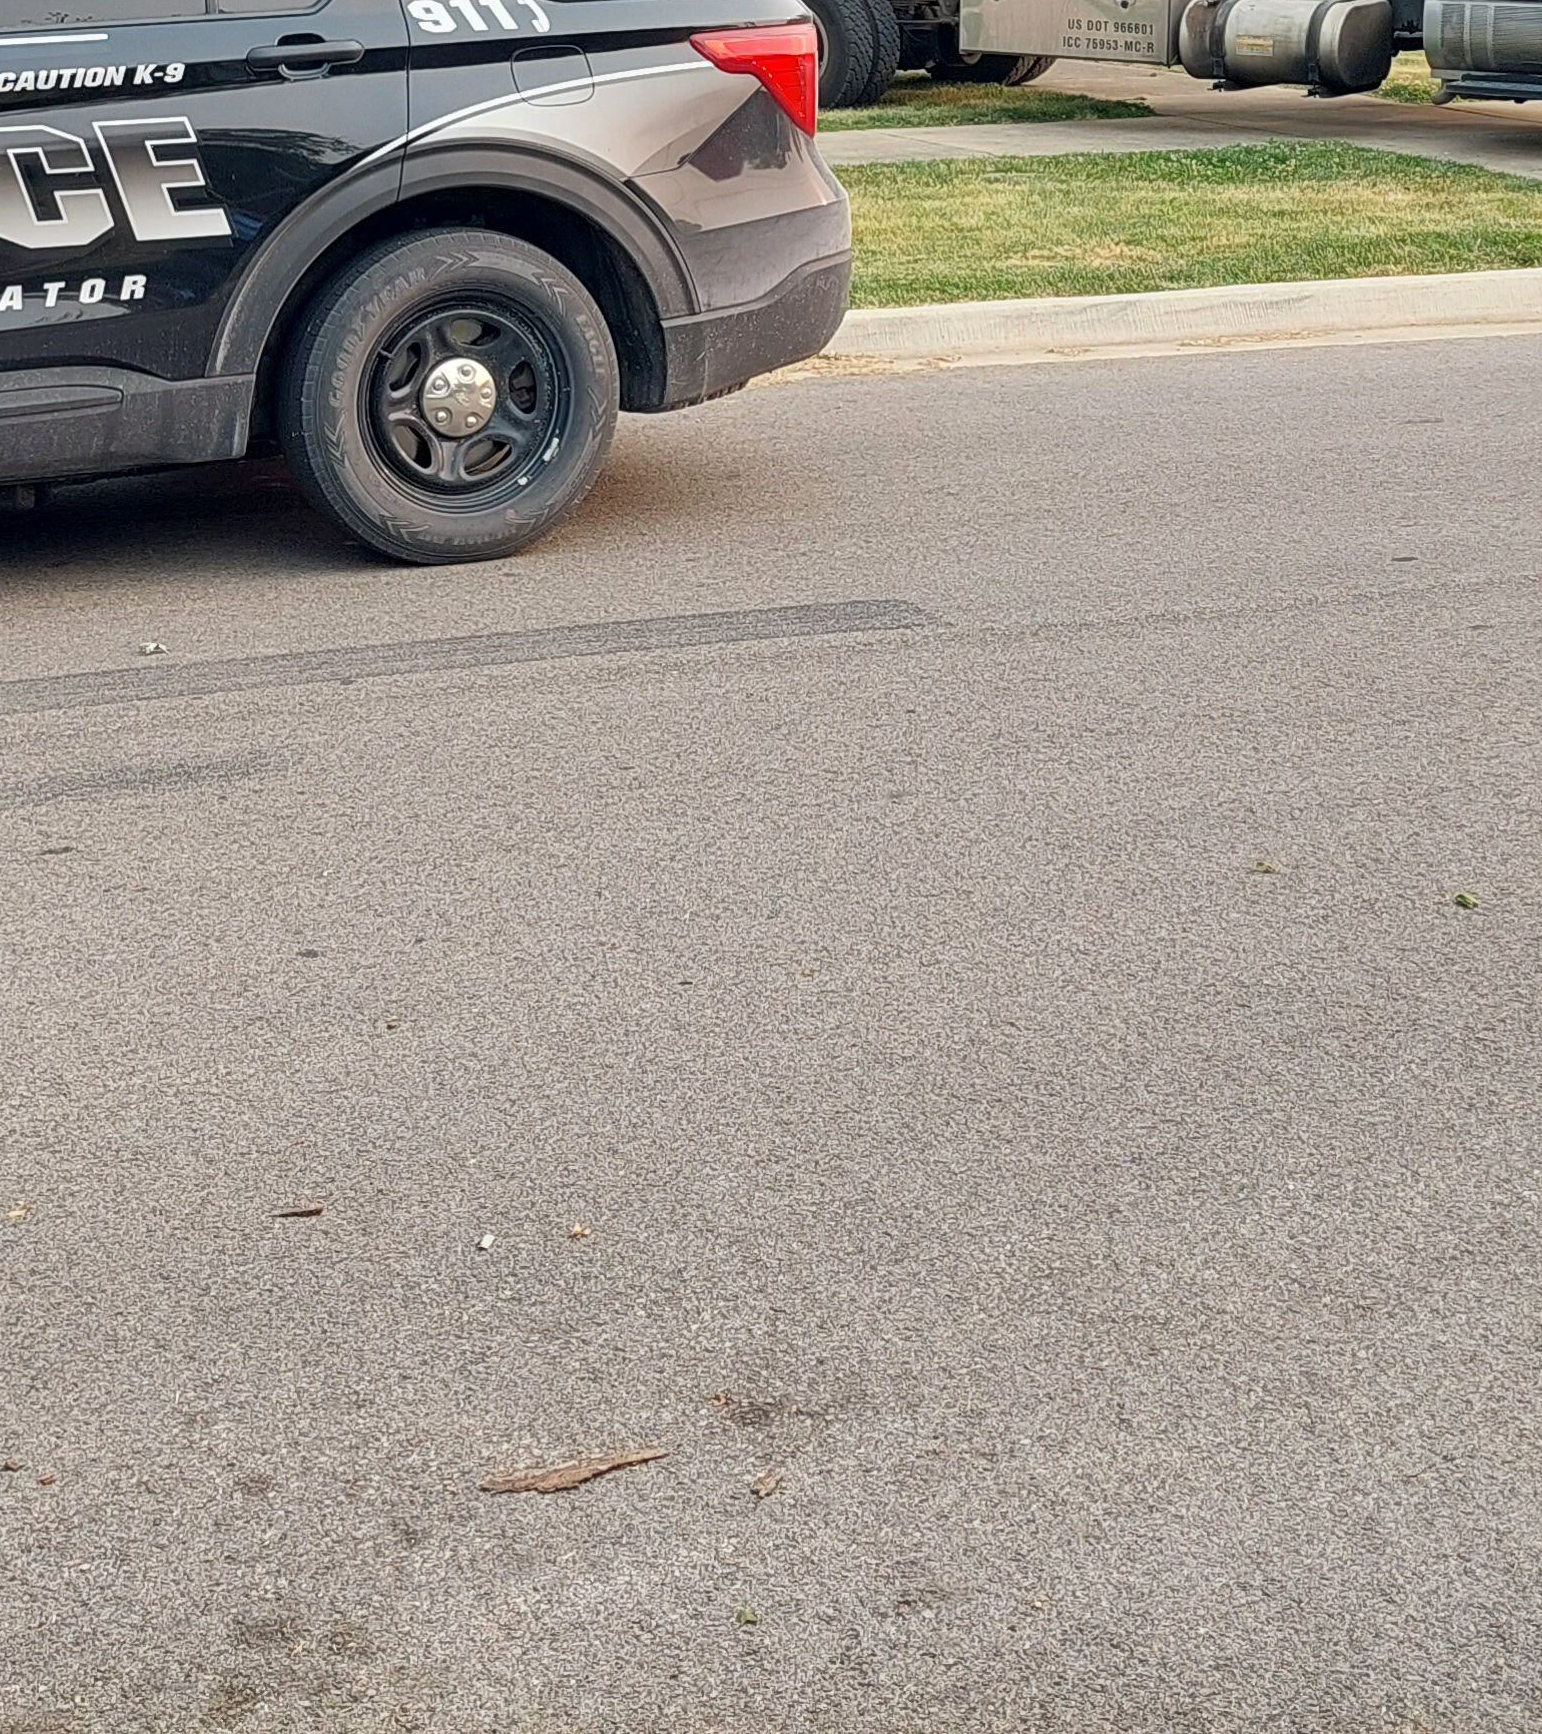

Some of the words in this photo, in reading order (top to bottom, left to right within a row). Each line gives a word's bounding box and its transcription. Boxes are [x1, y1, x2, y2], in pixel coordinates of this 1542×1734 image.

[1067, 18, 1083, 31] US
[1086, 19, 1110, 33] DOT
[1113, 21, 1154, 36] 966601
[1062, 35, 1081, 49] ICC
[132, 62, 186, 85] K-9
